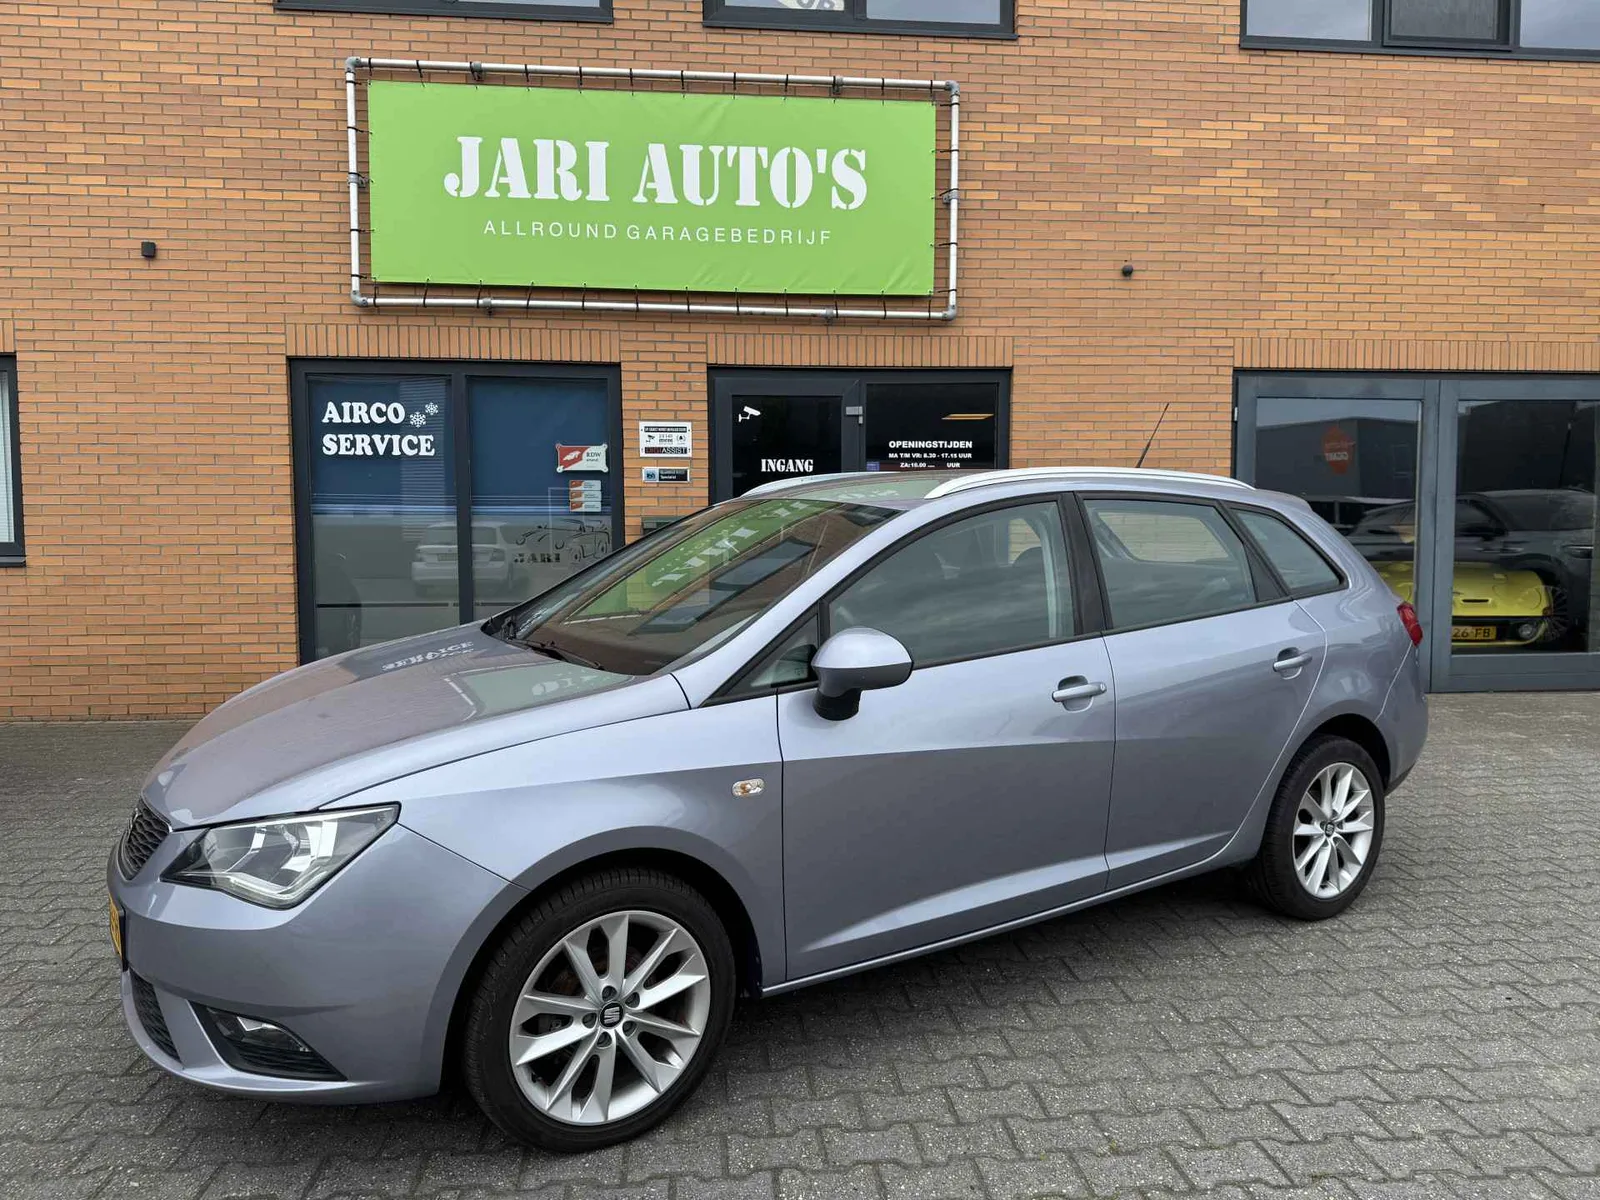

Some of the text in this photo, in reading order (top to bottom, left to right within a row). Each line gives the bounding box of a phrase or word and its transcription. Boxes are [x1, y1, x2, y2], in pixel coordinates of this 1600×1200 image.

[444, 136, 868, 211] JARI AUTO'S
[483, 219, 832, 246] ALLROUND GARAGEBEDRIJF
[321, 401, 406, 424] AIRCO
[322, 433, 436, 456] SERVICE
[888, 440, 973, 449] OPENINGSTIJDEN
[760, 458, 814, 473] INGANG
[514, 552, 561, 564] JARI
